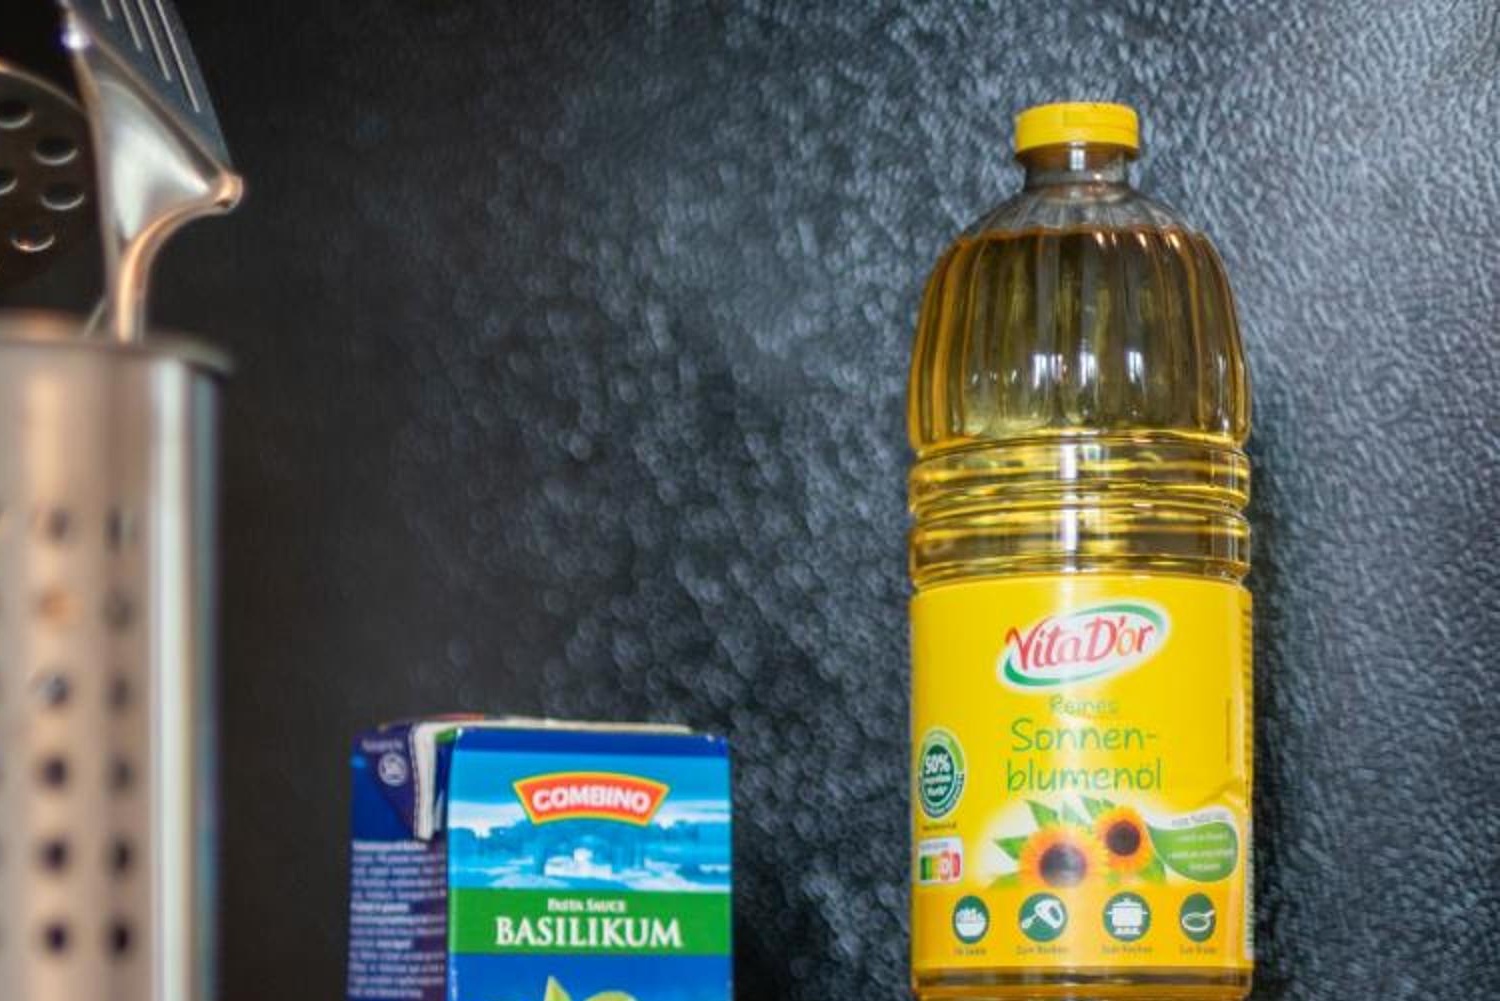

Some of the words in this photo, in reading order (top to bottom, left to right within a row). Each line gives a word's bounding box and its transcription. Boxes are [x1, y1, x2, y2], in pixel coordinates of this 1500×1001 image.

[1005, 616, 1082, 671] Vita
[1084, 616, 1155, 662] D'or
[1011, 717, 1158, 752] Sonnen-
[1006, 757, 1162, 792] blumenöl
[532, 785, 651, 813] COMBINO
[496, 916, 683, 948] BASILIKUM
